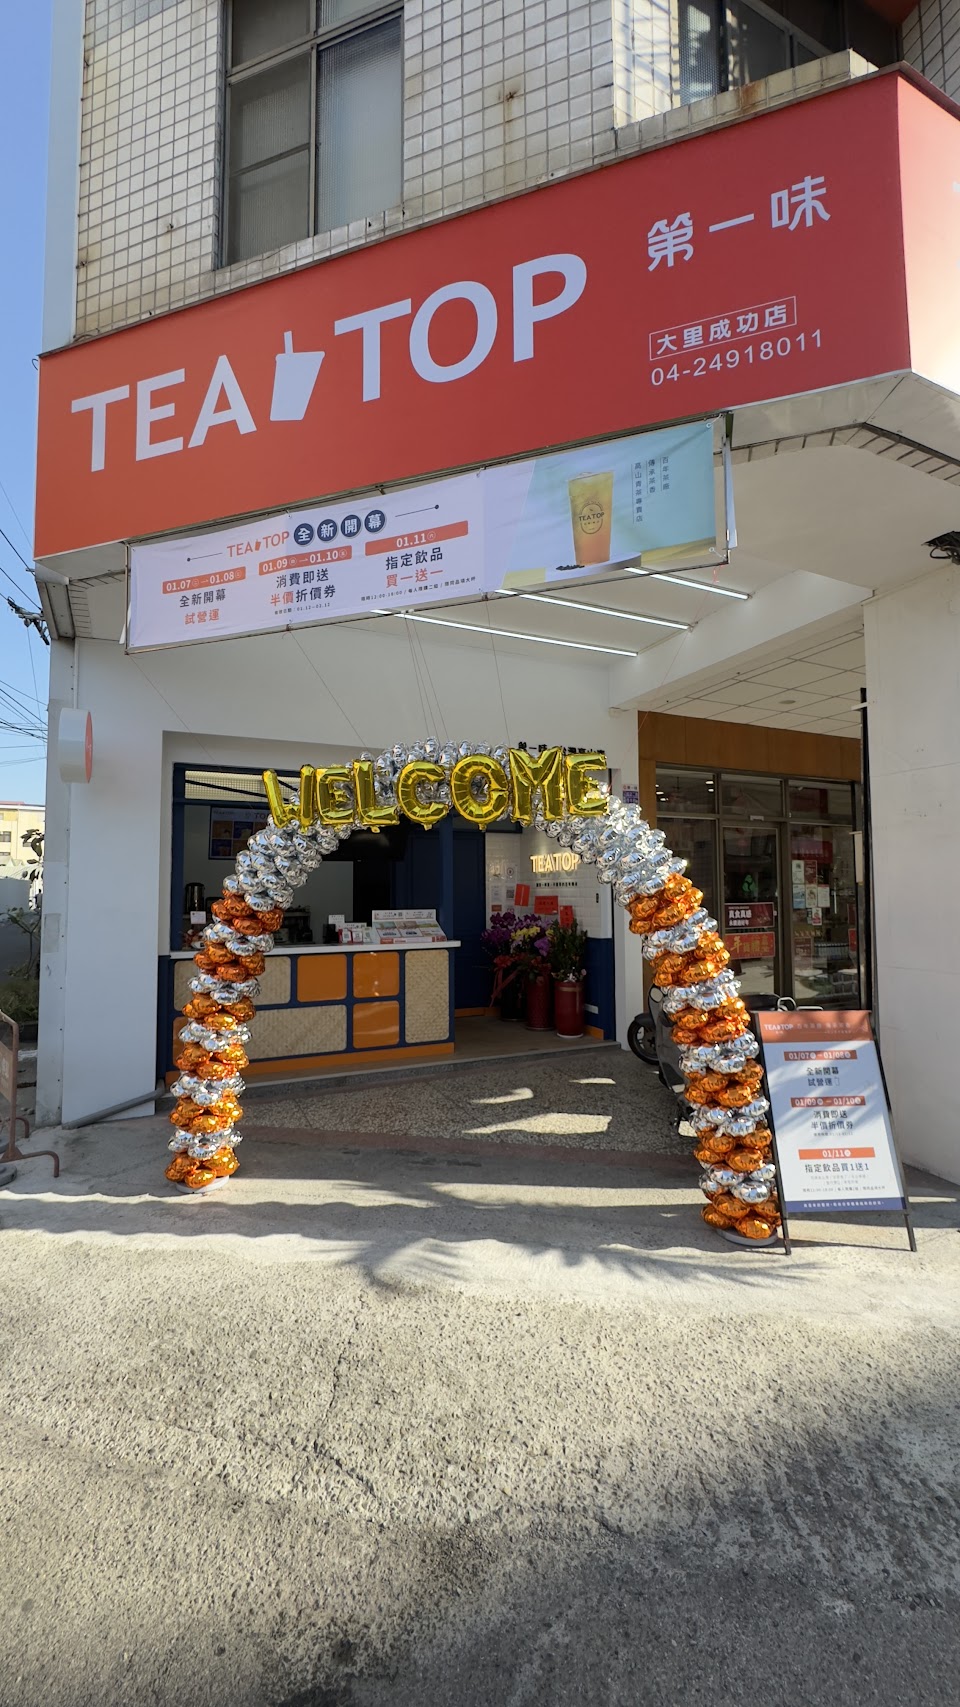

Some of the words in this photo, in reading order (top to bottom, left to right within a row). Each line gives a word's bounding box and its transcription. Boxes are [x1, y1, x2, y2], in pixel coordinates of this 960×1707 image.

[648, 175, 831, 272] 第一味
[656, 304, 787, 355] 大里成功店
[72, 354, 257, 472] TEA
[334, 253, 588, 402] TOP
[651, 329, 821, 386] 04-24918011
[297, 513, 382, 542] 全新開幕
[385, 547, 443, 571] 指定飲品
[276, 568, 329, 588] 消費即送
[386, 567, 444, 588] 買一送一
[179, 588, 227, 608] 全新開幕
[270, 585, 336, 606] 半價折價券
[184, 609, 220, 625] 試營運
[262, 746, 609, 833] WELCOME
[806, 1067, 839, 1076] 全新開幕
[813, 1110, 848, 1119] 消費即送
